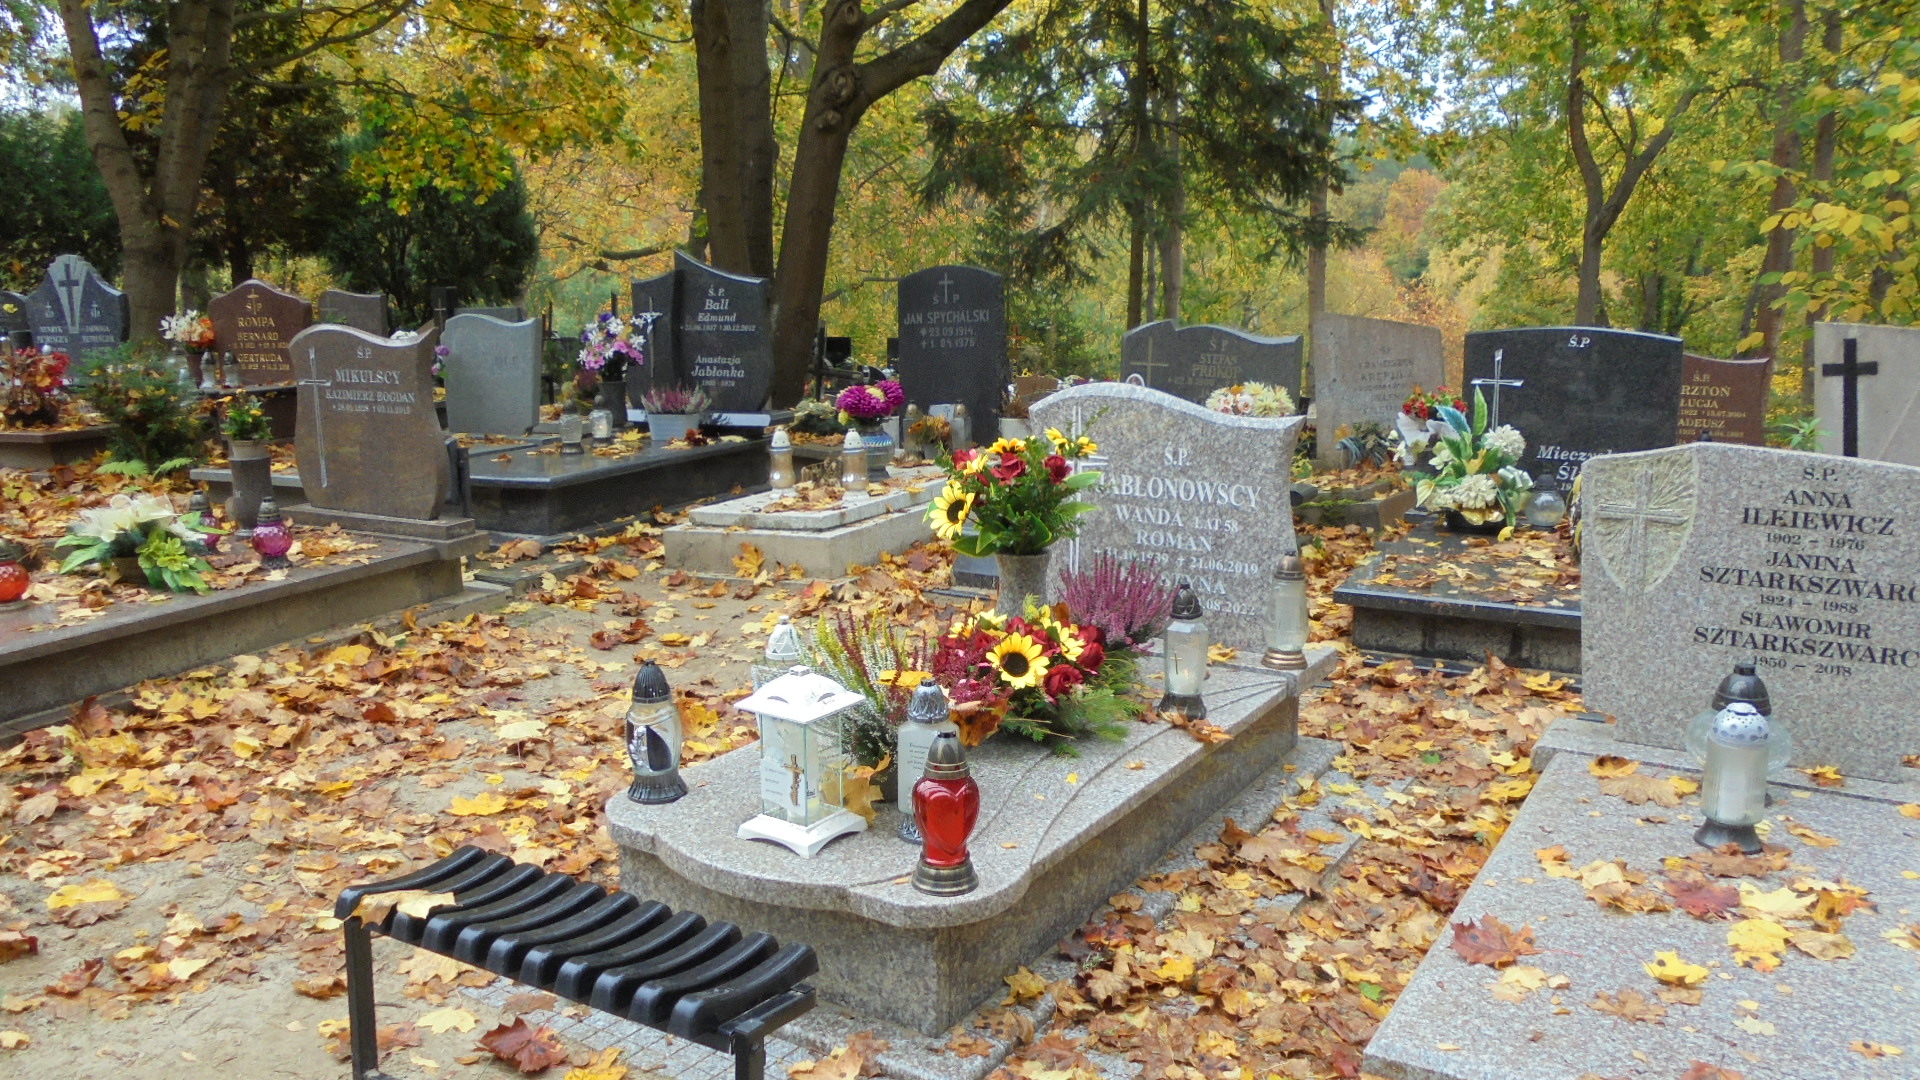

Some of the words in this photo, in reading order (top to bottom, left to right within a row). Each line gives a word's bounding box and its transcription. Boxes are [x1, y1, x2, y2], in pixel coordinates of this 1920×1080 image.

[703, 299, 730, 310] Ball
[238, 316, 276, 328] ROMPA
[697, 312, 737, 322] Edmund
[903, 311, 923, 325] JAN
[926, 309, 990, 325] SPYCHALSKI
[236, 331, 280, 341] BERNARD
[694, 355, 742, 366] Anastazja
[335, 368, 401, 385] MIKULSCY
[690, 365, 745, 378] Jabłonka
[325, 389, 375, 401] KAZIMIERZ
[376, 391, 416, 404] BOGDAN
[1680, 384, 1732, 398] RZTOŃ
[1677, 418, 1726, 429] ADEUSZ
[1782, 489, 1853, 510] ANNA
[1113, 503, 1184, 528] WANDA
[1195, 517, 1222, 531] LAT
[1224, 519, 1240, 534] 58
[1740, 506, 1896, 536] ILKIEWICZ
[1135, 529, 1213, 552] ROMAN
[1765, 532, 1802, 546] 1902
[1828, 537, 1866, 551] 1976
[1188, 556, 1259, 575] 21.06.2019
[1765, 551, 1858, 575] JANINA
[1822, 600, 1859, 615] 1988
[1739, 609, 1872, 640] SŁAWOMIR
[1693, 626, 1920, 669] SZTARKSZWARC
[1751, 655, 1788, 670] 1950
[1814, 662, 1853, 677] 2018
